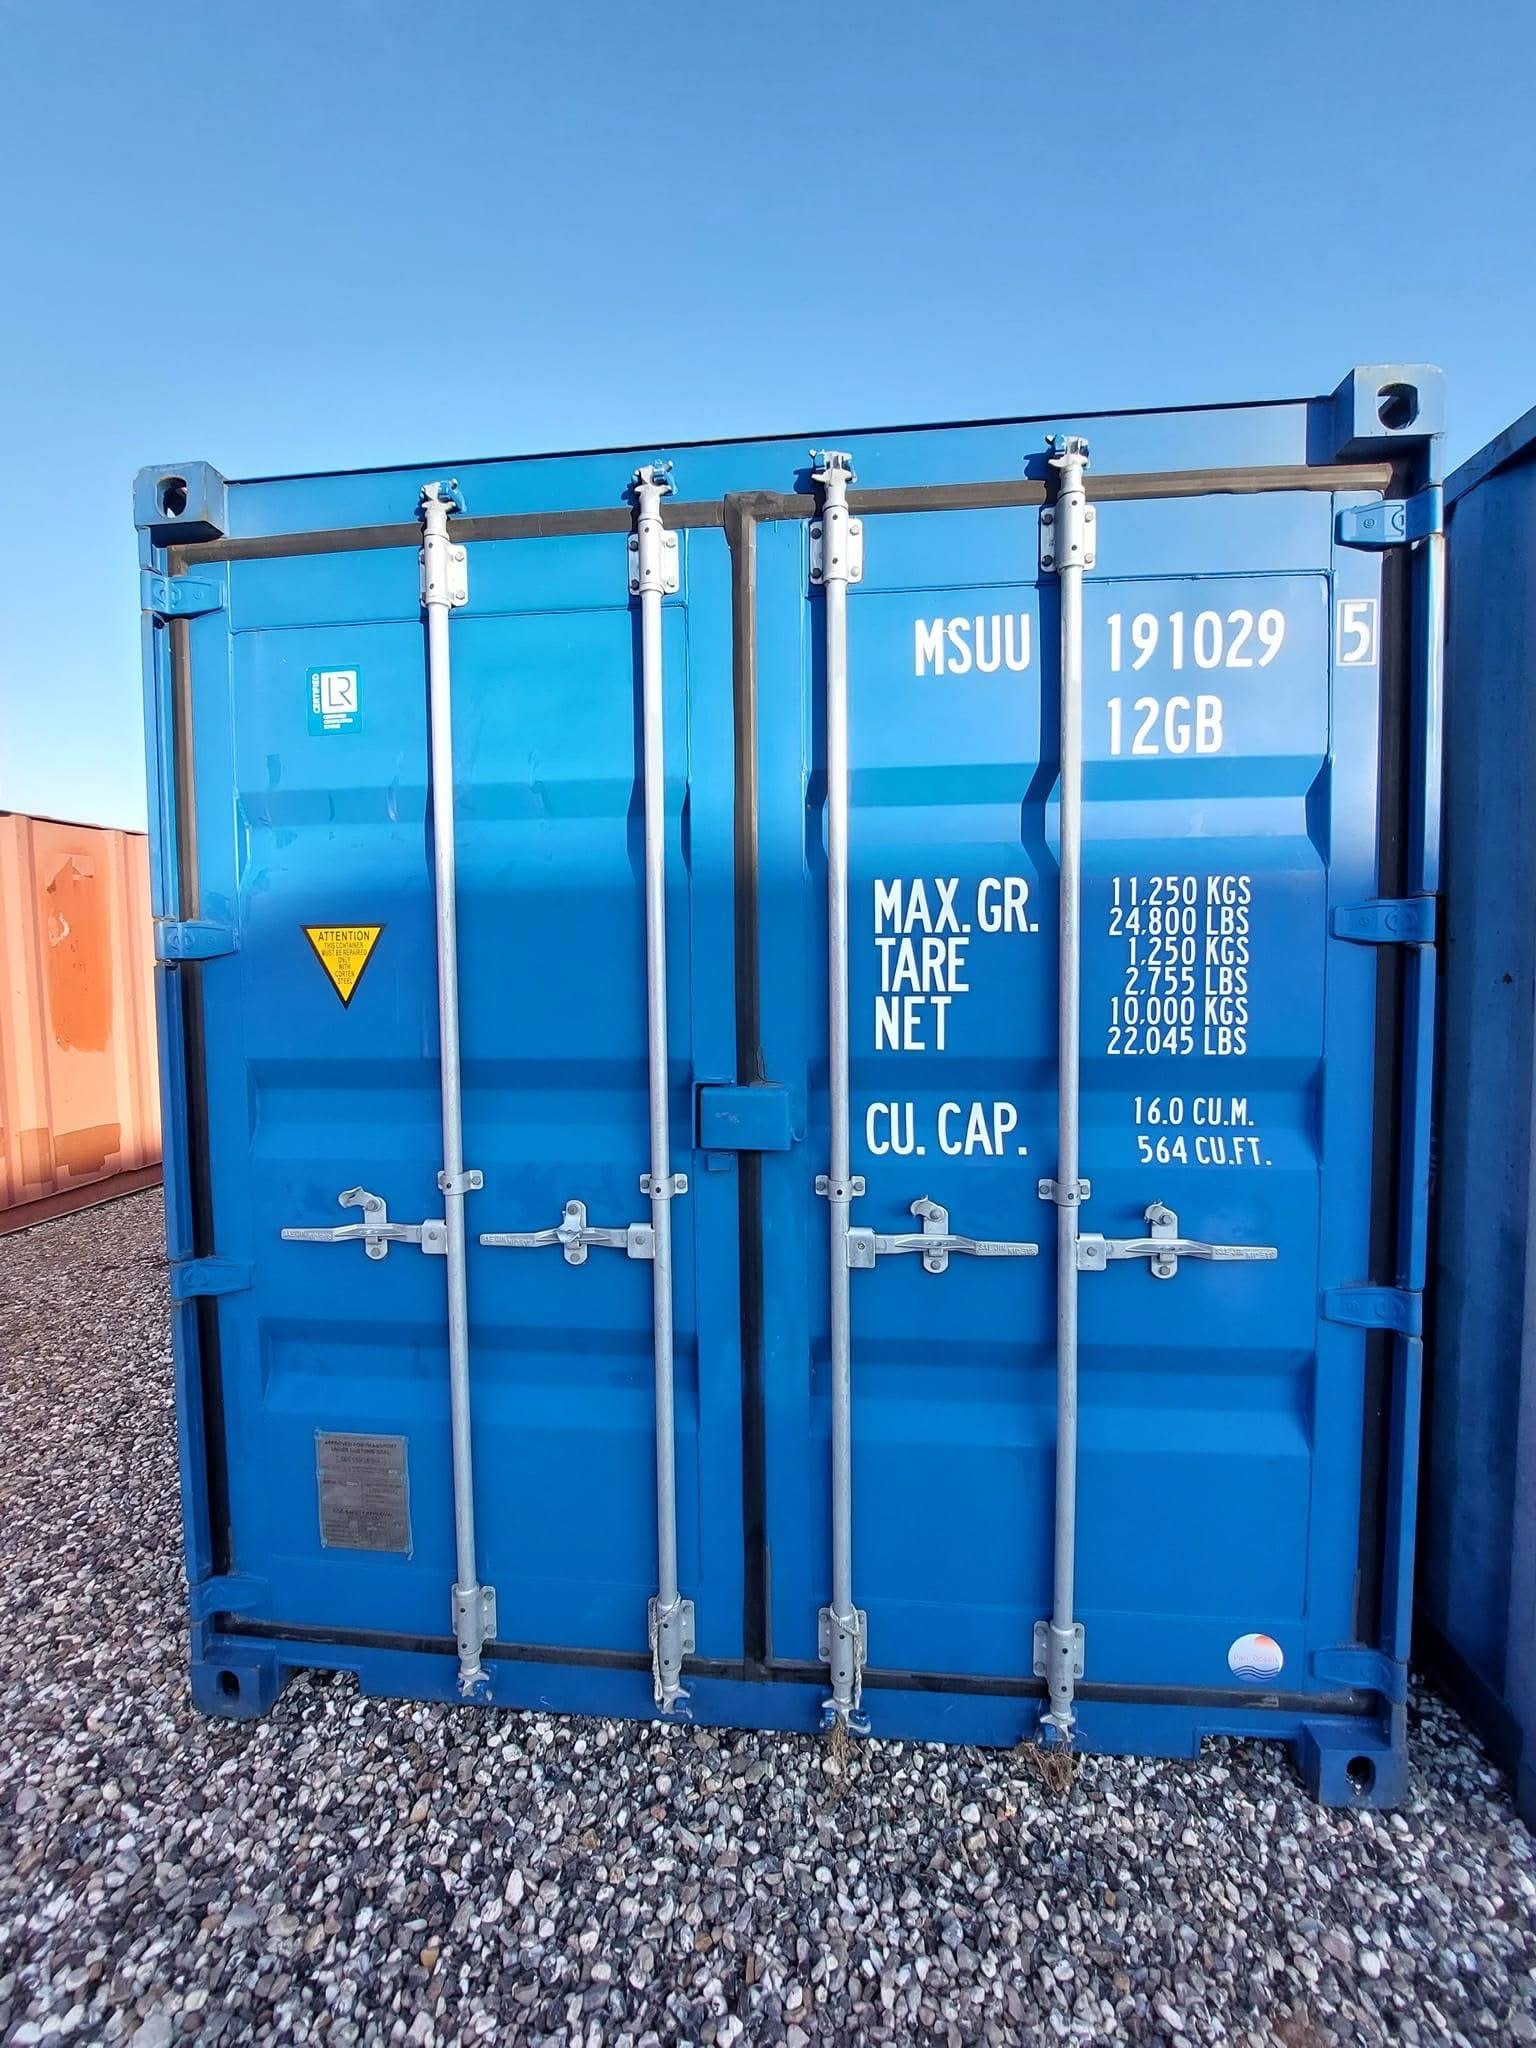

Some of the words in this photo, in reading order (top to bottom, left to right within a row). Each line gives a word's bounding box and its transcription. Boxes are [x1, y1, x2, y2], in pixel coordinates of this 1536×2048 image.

[915, 614, 1031, 676] MSUU
[1107, 609, 1286, 671] 191029
[1343, 602, 1370, 662] 5
[1107, 695, 1224, 755] 12GB
[1112, 875, 1196, 906] 11,250
[1207, 875, 1251, 905] KGS
[1109, 906, 1197, 936] 24,800
[1206, 906, 1249, 935] LBS
[318, 931, 370, 942] ATTENTION
[1128, 936, 1196, 966] 1,250
[1205, 936, 1250, 965] KGS
[337, 956, 351, 964] ONLY
[875, 936, 970, 993] TARE
[337, 977, 353, 985] STEEL
[1125, 966, 1195, 996] 2,755
[1205, 966, 1248, 995] LBS
[875, 995, 952, 1052] NET
[1111, 996, 1195, 1026] 10,000
[1204, 996, 1249, 1025] KGS
[1107, 1026, 1194, 1056] 22,045
[1204, 1026, 1247, 1055] LBS
[1134, 1097, 1184, 1125] 16.0
[866, 1102, 926, 1155] CU.
[938, 1102, 1028, 1156] CAP.
[1137, 1136, 1188, 1164] 564
